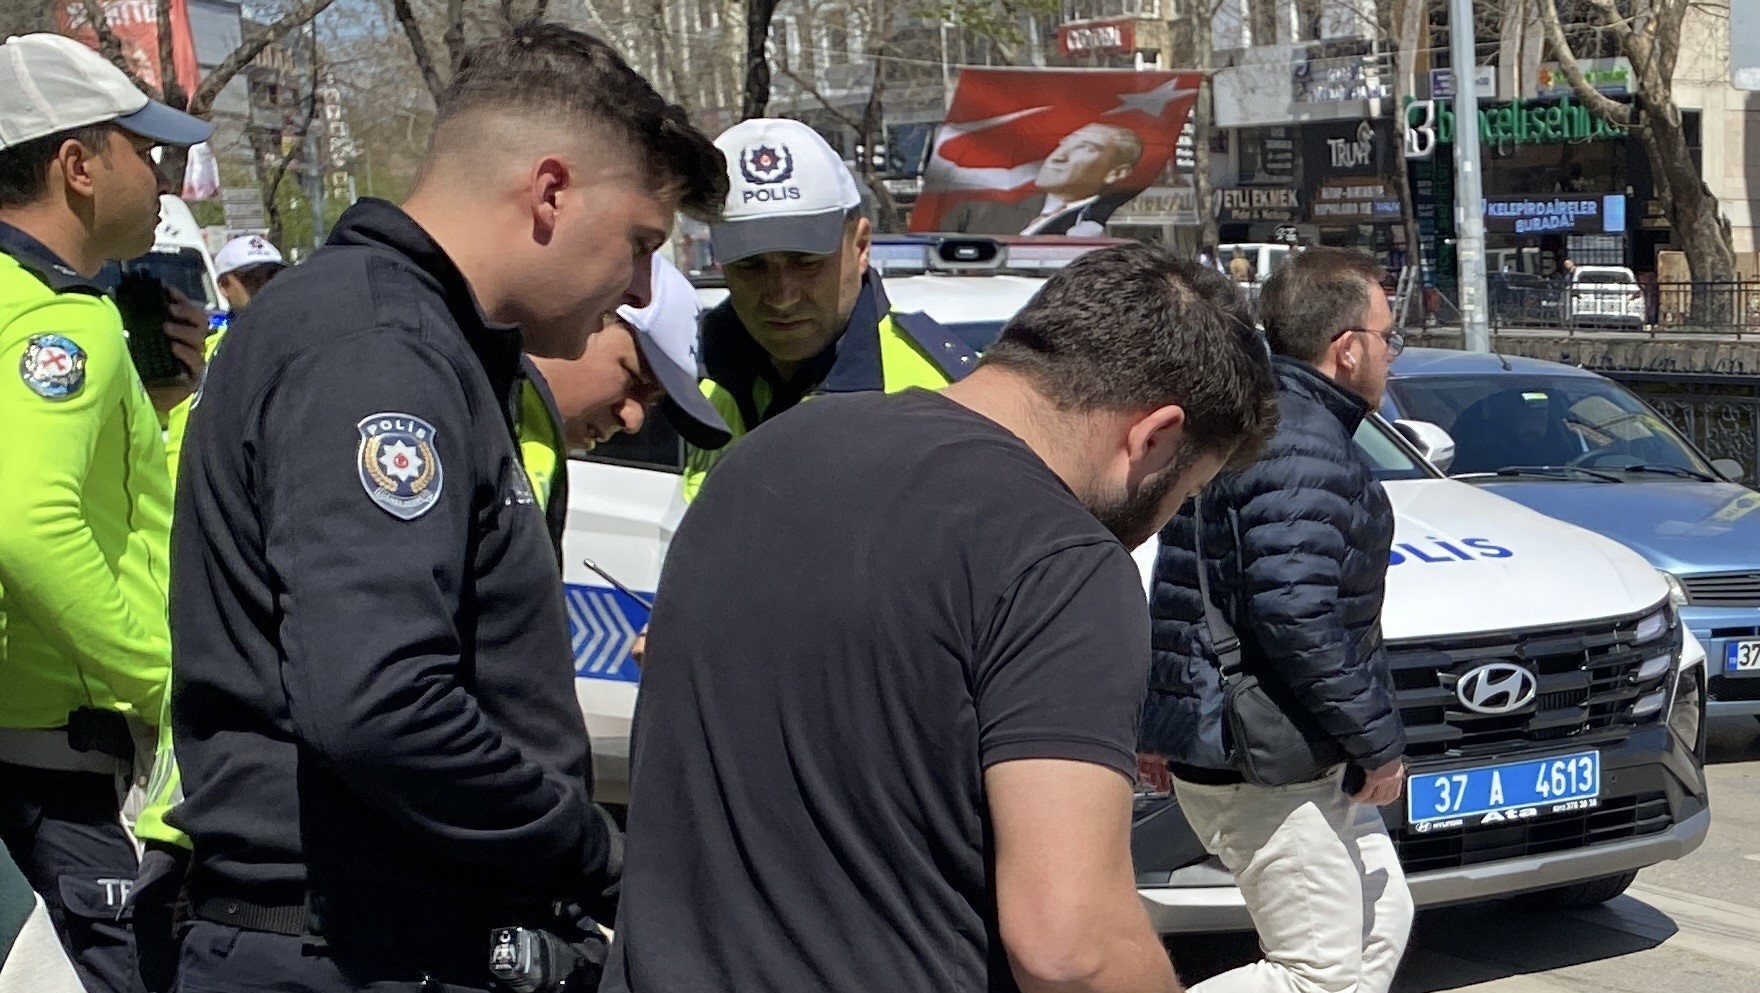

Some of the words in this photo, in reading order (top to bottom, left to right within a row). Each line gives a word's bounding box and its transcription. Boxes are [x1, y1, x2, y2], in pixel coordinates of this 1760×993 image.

[367, 419, 427, 439] POLİS
[1390, 536, 1513, 565] LİS
[1434, 774, 1468, 813] 37
[1489, 770, 1504, 806] A
[1535, 756, 1593, 798] 4613
[1481, 807, 1538, 824] Ata
